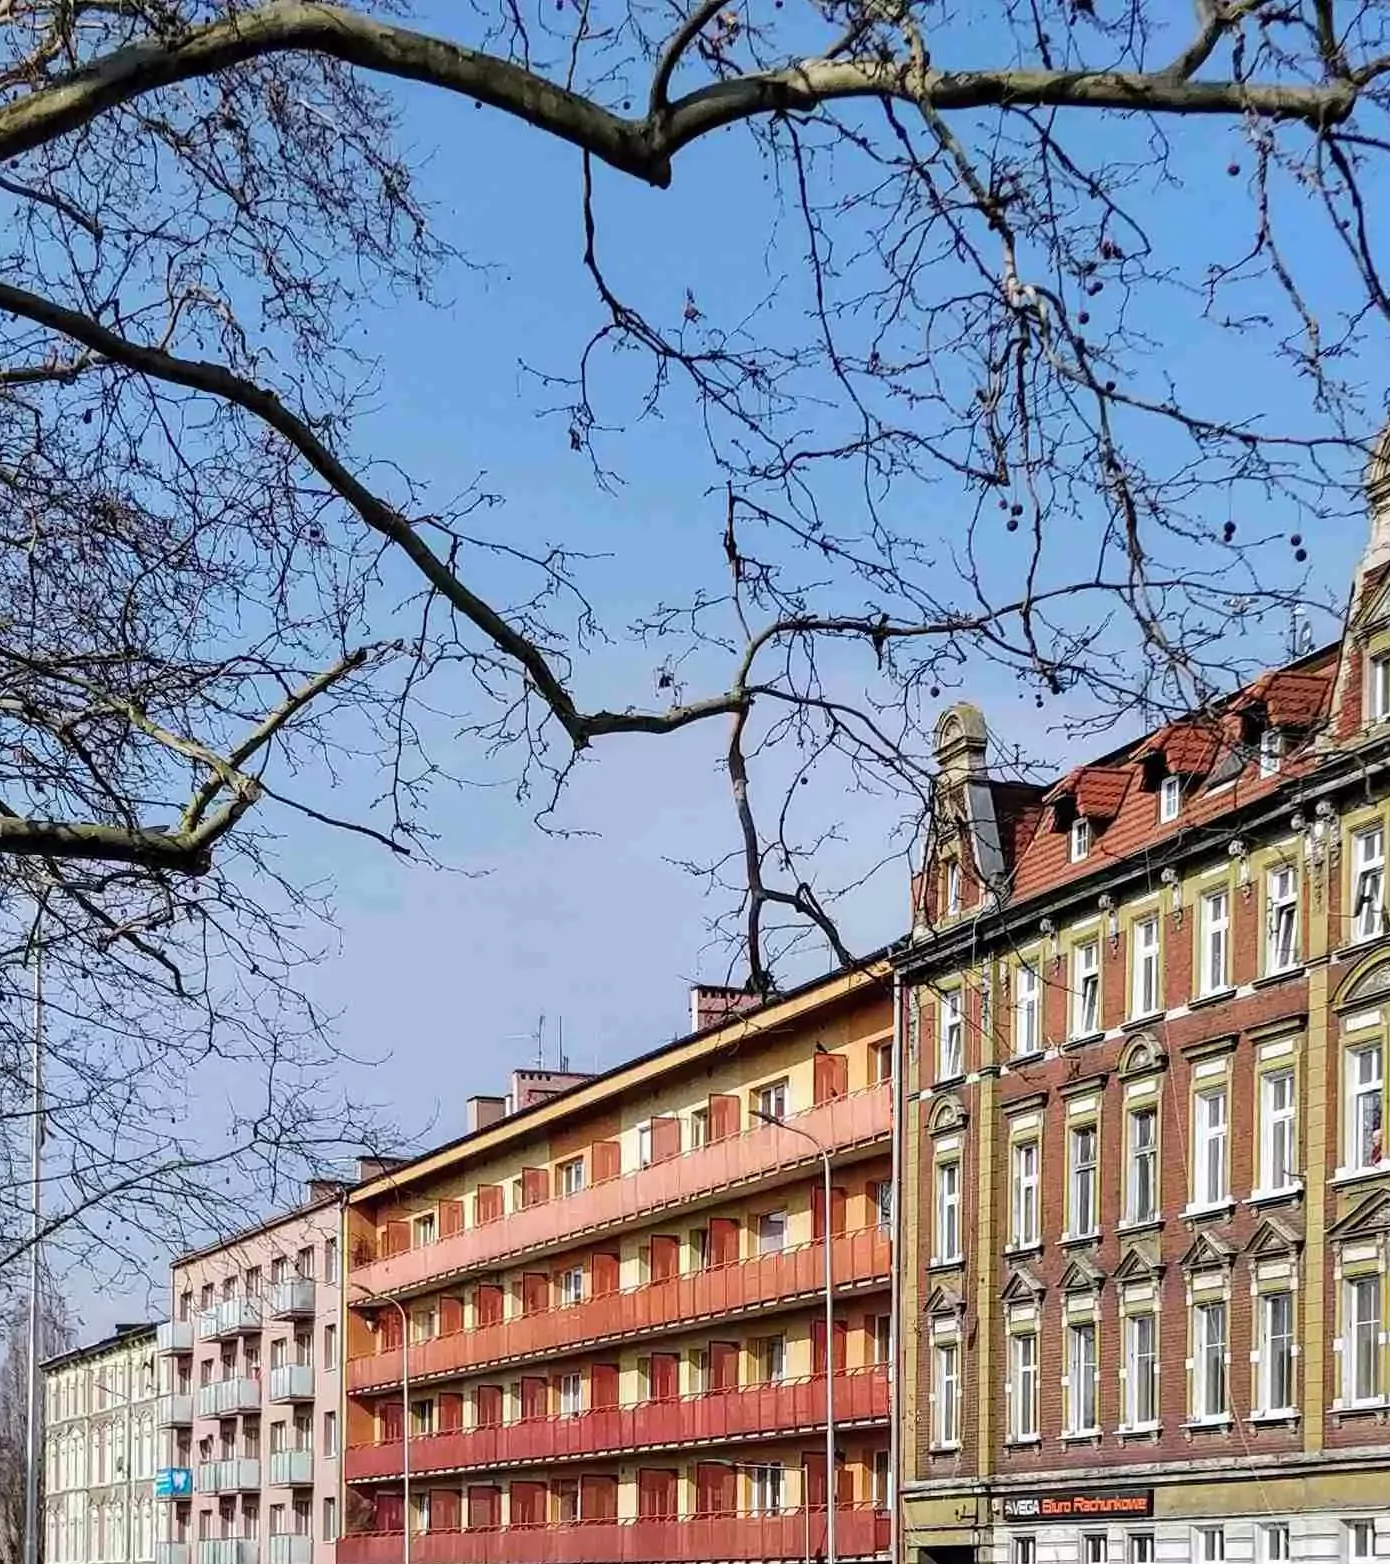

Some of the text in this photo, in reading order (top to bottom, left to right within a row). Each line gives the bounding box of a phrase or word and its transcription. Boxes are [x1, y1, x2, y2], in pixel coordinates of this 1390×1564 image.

[1013, 1495, 1147, 1515] VEGA Biuro Rachunkowe
